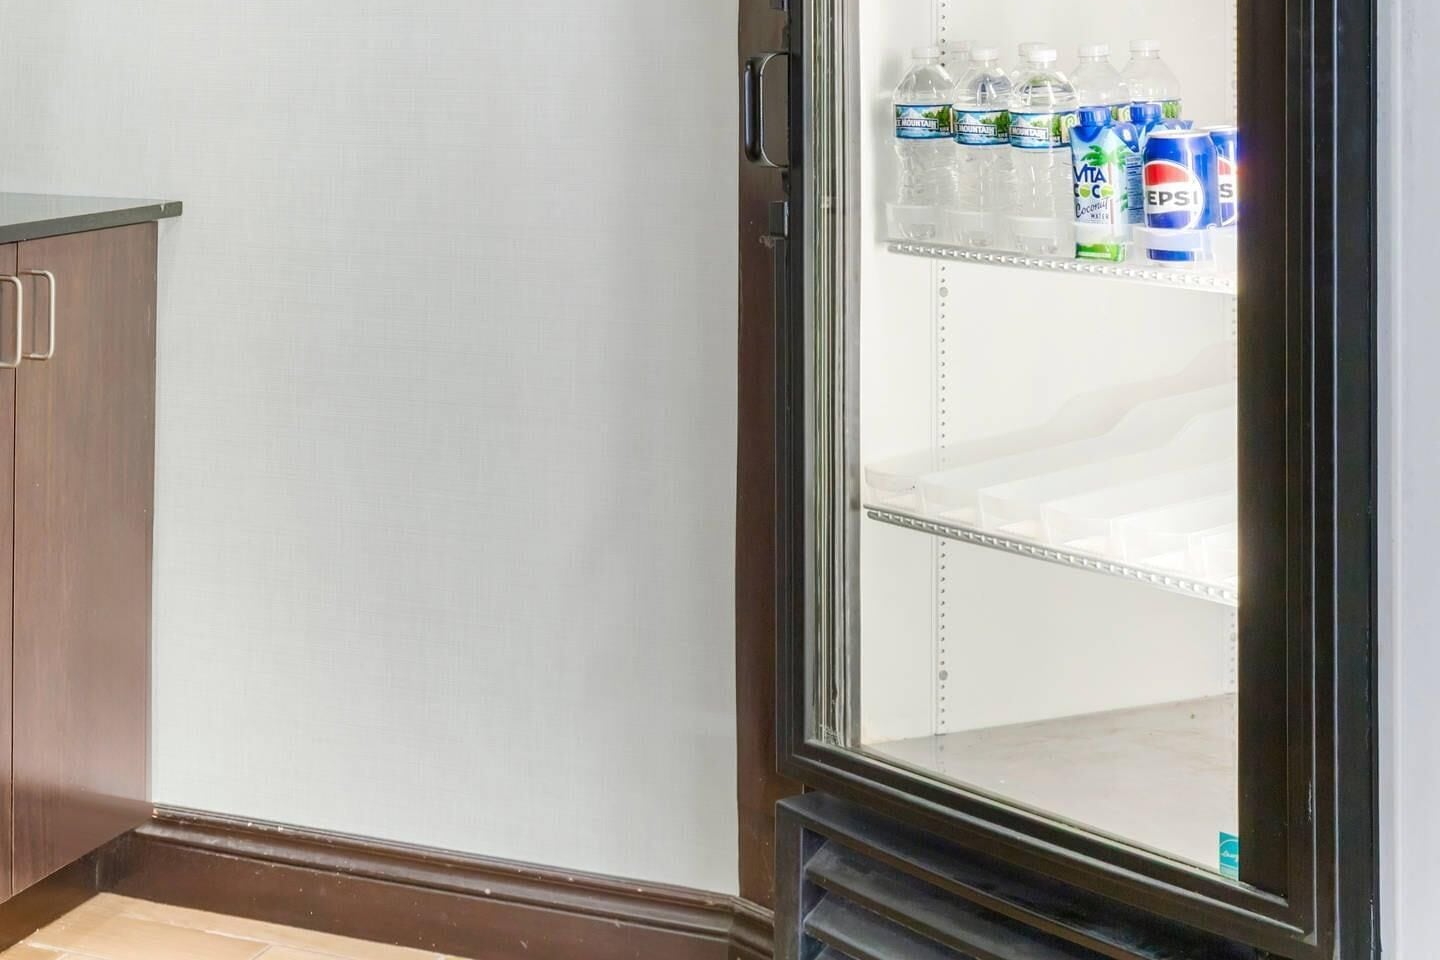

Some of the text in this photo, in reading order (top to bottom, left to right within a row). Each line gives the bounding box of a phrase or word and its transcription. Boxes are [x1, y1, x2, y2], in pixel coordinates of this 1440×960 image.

[1073, 164, 1106, 183] VITA
[1147, 190, 1198, 206] EPSI
[1075, 198, 1108, 218] Coconut
